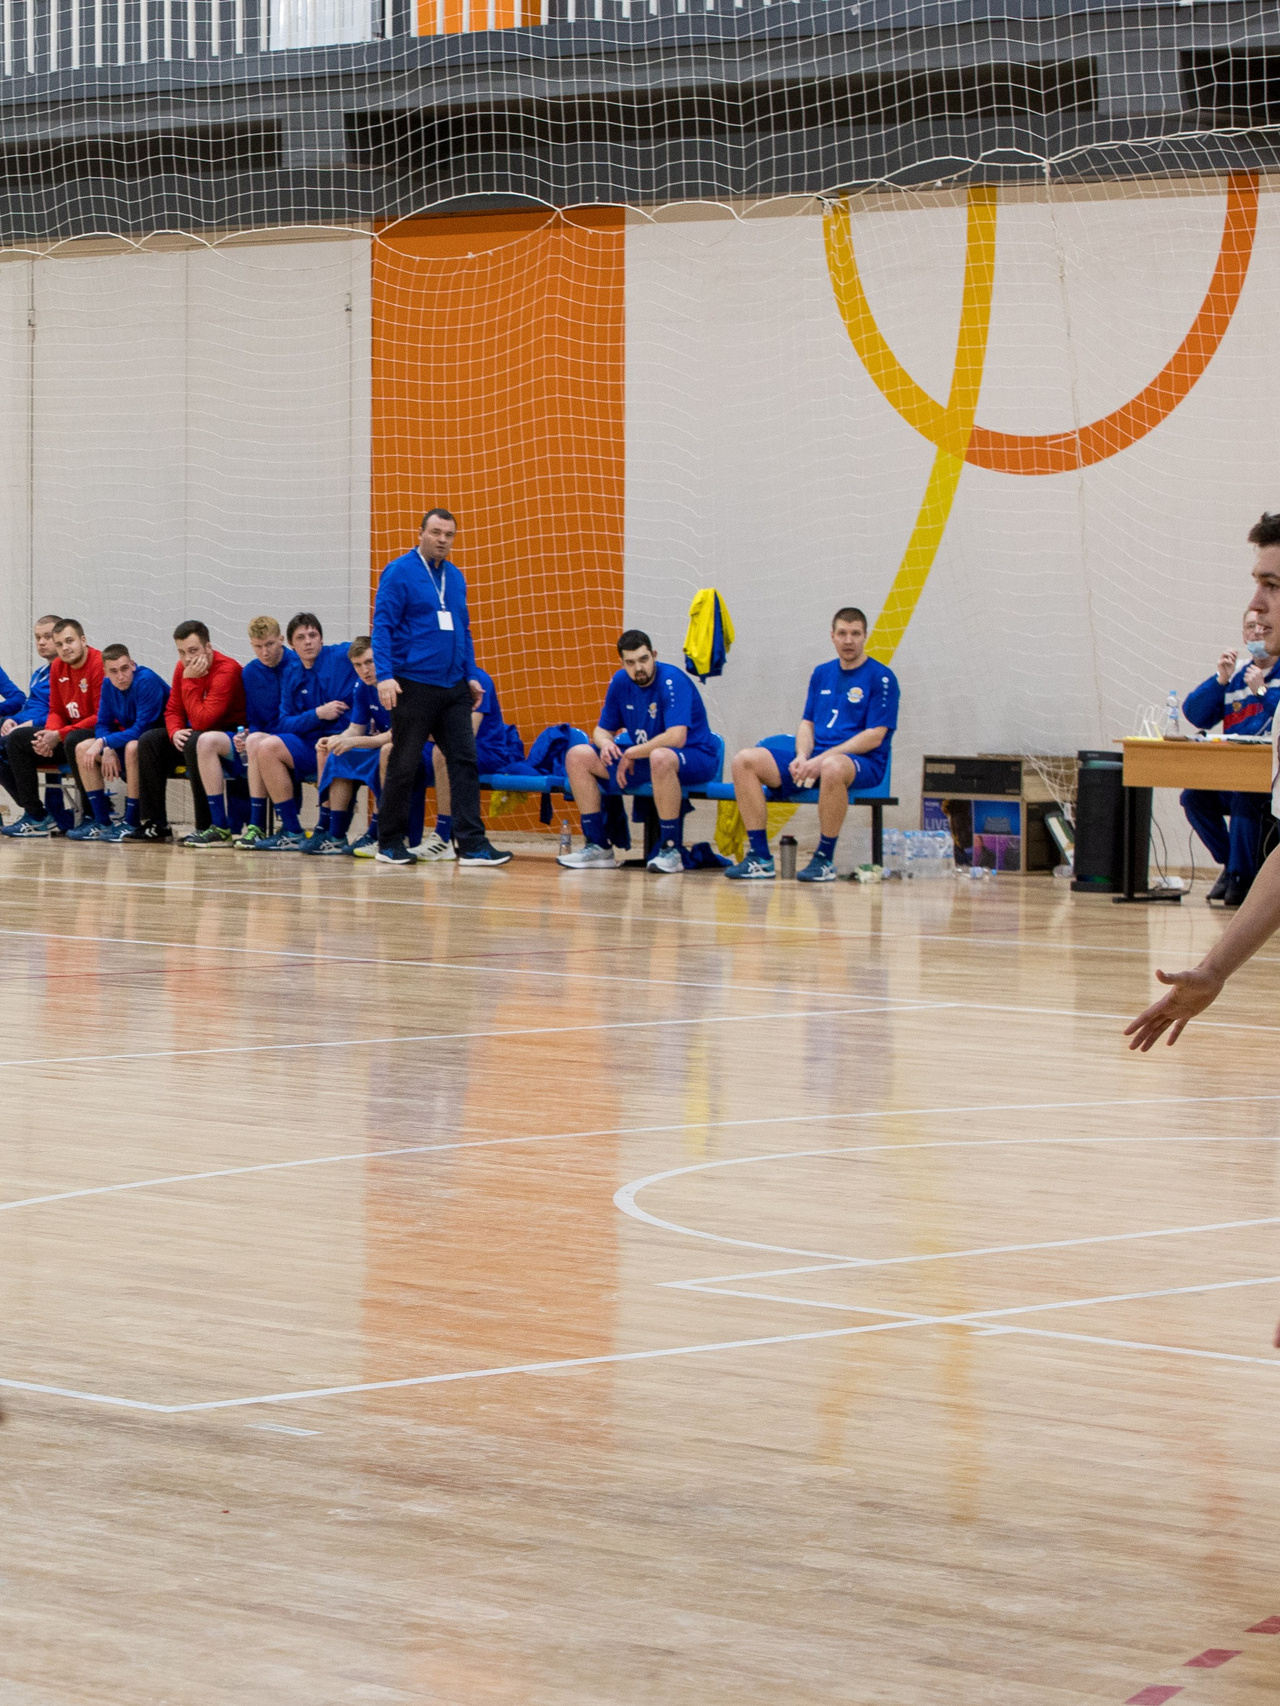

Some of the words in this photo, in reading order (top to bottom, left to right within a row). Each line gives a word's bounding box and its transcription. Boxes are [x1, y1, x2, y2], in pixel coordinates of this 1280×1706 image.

[65, 701, 80, 719] 16
[826, 708, 839, 729] 7
[925, 817, 949, 831] LIVE
